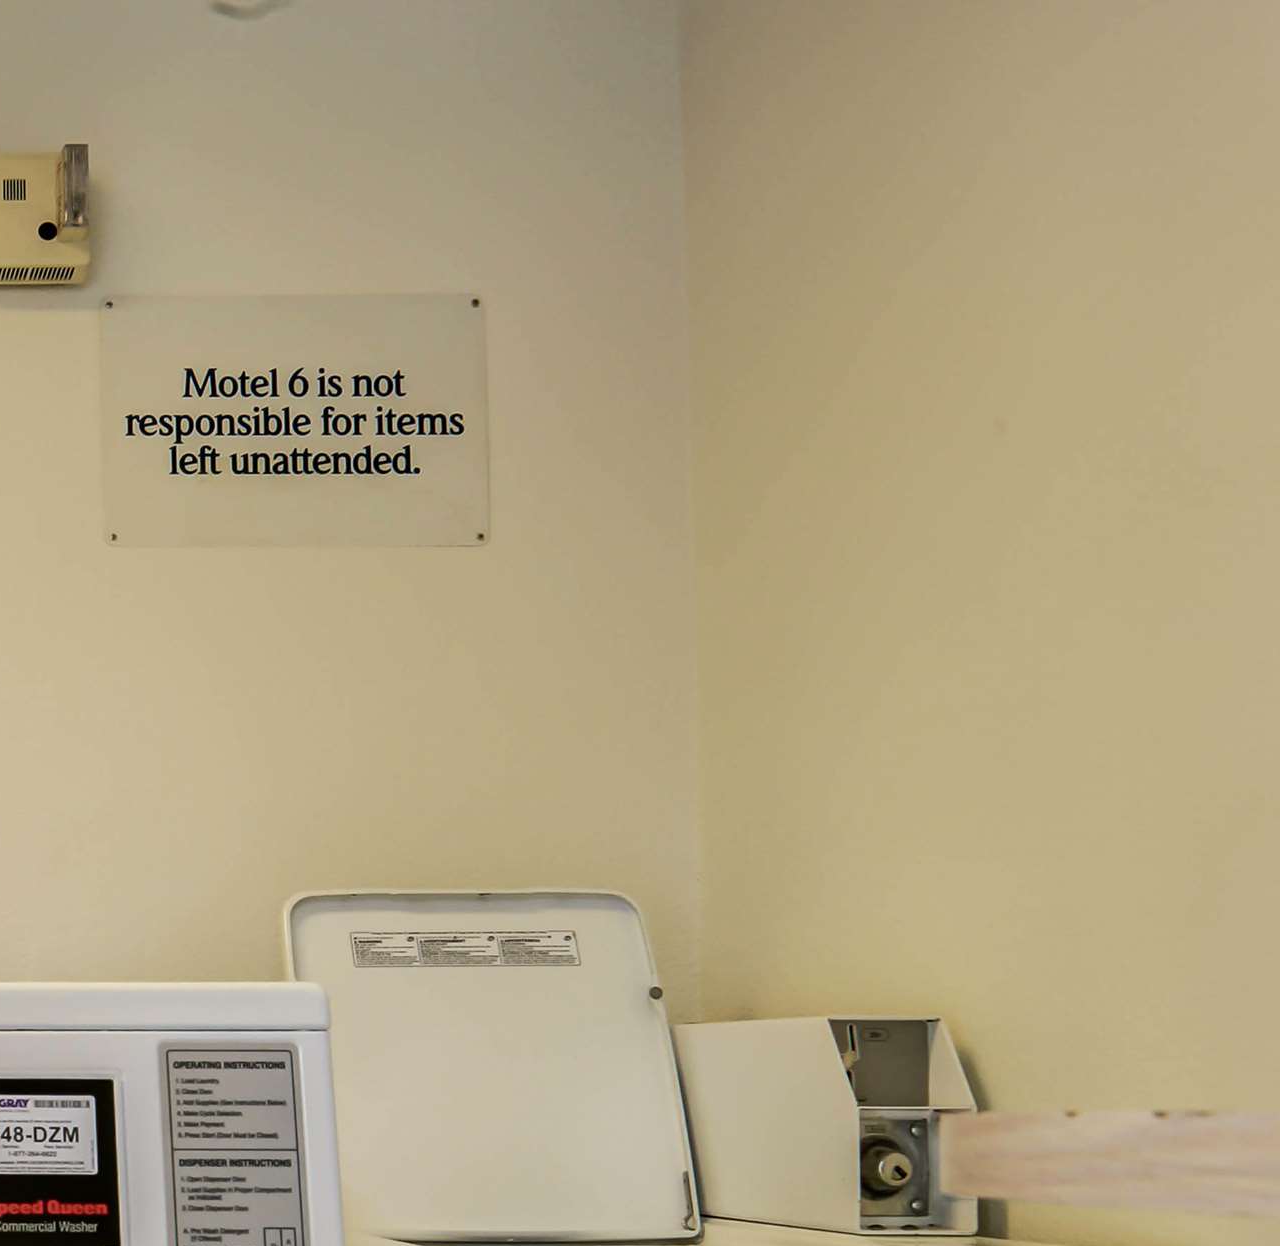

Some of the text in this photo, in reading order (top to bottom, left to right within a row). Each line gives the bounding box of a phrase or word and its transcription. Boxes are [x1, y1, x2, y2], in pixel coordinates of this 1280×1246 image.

[182, 368, 406, 398] Motel 6 is not
[126, 407, 464, 443] responsible for items
[169, 446, 421, 475] left unattended.
[179, 1159, 291, 1167] DISPENSER INSTRUCTIONS
[47, 1200, 108, 1215] Queen
[59, 1221, 98, 1232] Washer
